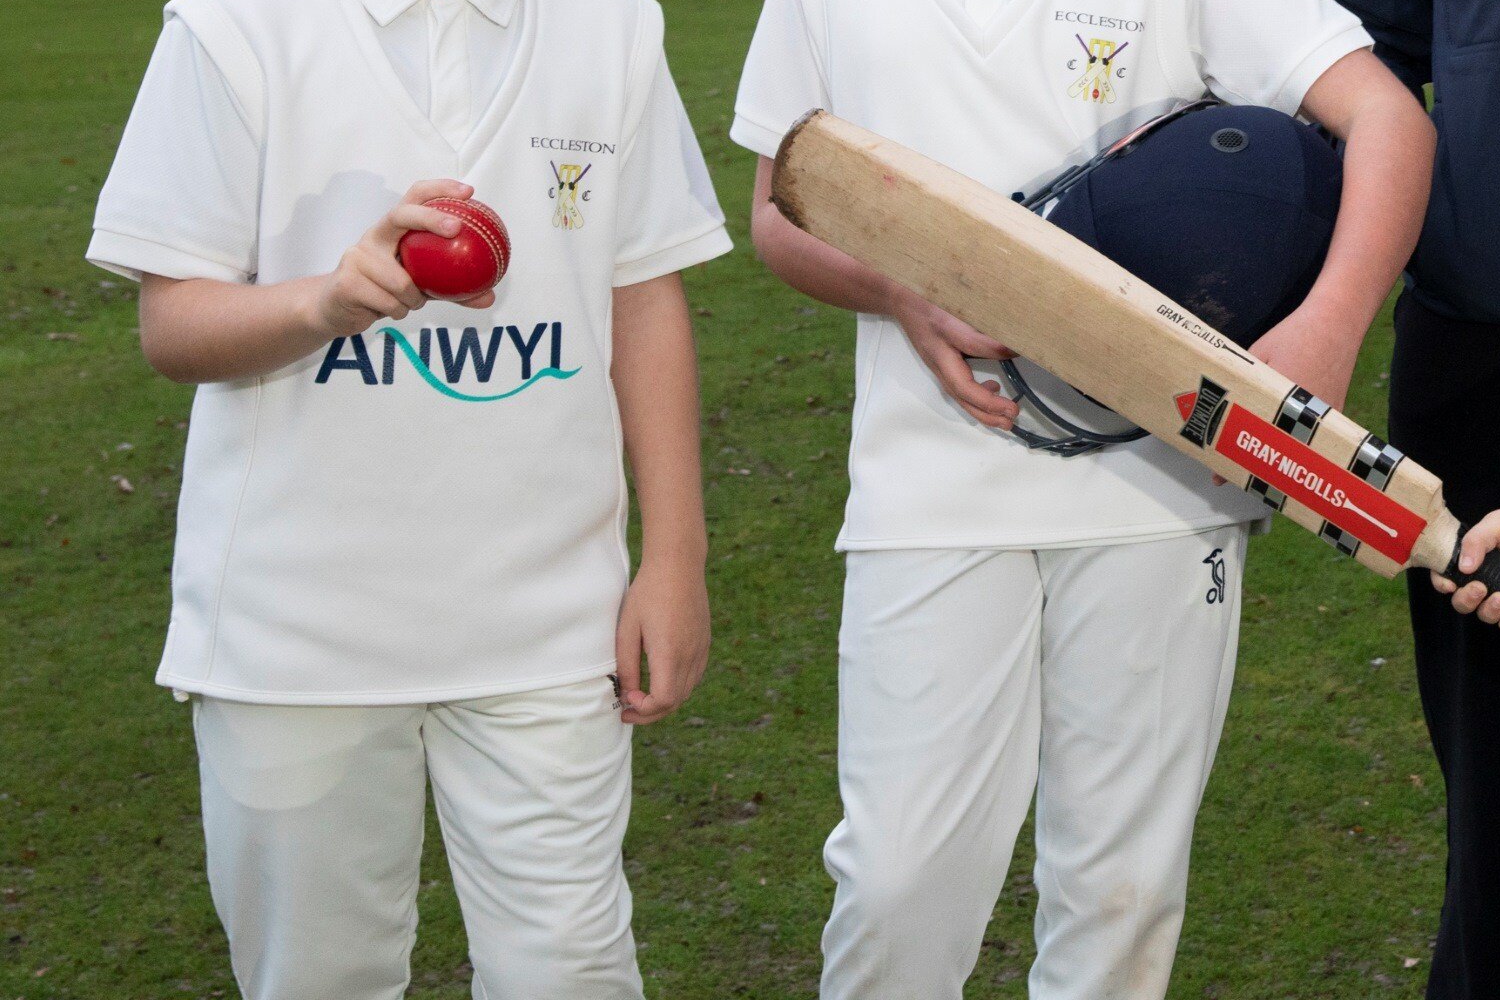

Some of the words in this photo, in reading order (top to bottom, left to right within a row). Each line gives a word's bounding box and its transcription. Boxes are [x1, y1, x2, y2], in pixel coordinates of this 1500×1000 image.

[531, 136, 616, 155] ECCLESTON
[314, 321, 583, 402] ANWYL
[1186, 387, 1221, 441] ULTIMATE
[1236, 430, 1346, 508] GRAY-NICOLLS
